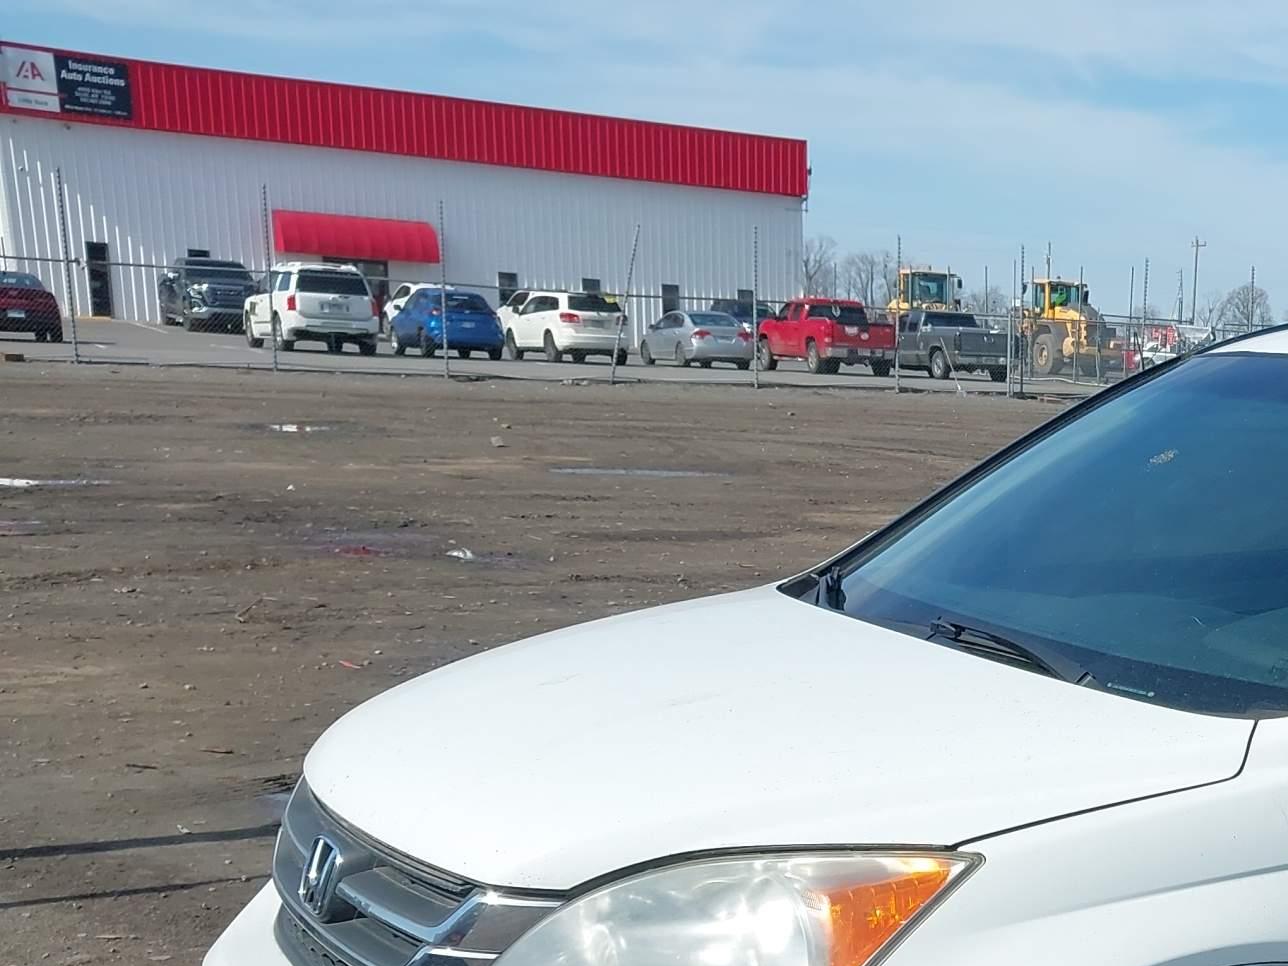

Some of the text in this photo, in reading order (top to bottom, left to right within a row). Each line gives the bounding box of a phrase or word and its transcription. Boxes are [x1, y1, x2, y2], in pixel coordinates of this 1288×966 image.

[68, 60, 115, 75] Insurance
[60, 70, 126, 87] Auto Auctions
